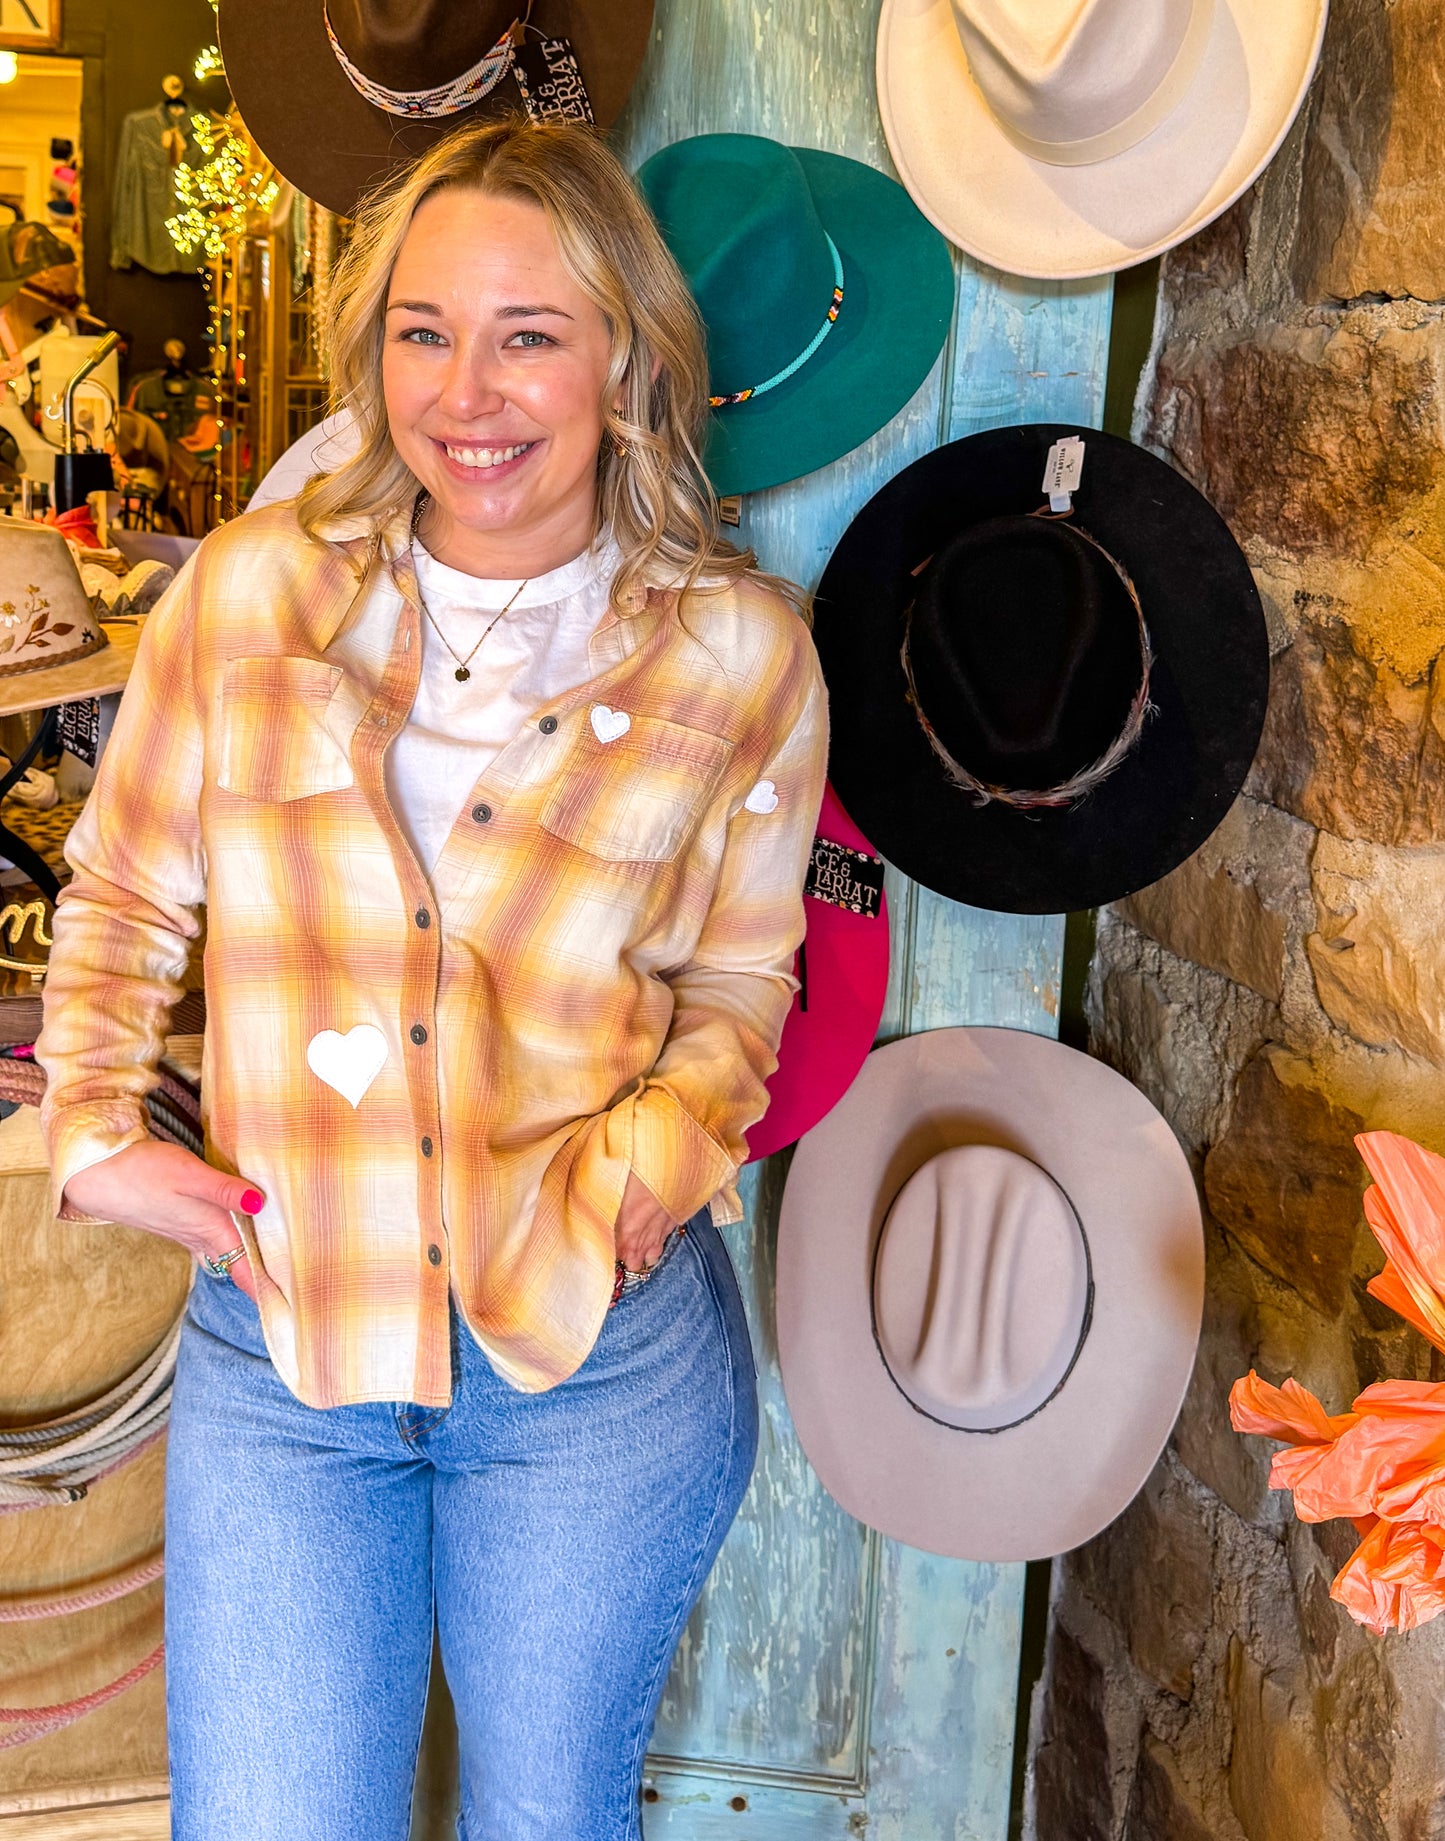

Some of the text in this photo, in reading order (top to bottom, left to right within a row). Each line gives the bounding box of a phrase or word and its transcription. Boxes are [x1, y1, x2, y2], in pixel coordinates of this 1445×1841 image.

[538, 83, 556, 97] &
[63, 705, 77, 741] LACE
[76, 699, 92, 741] LARIA
[814, 849, 851, 877] CE &
[814, 867, 878, 907] LARIAT
